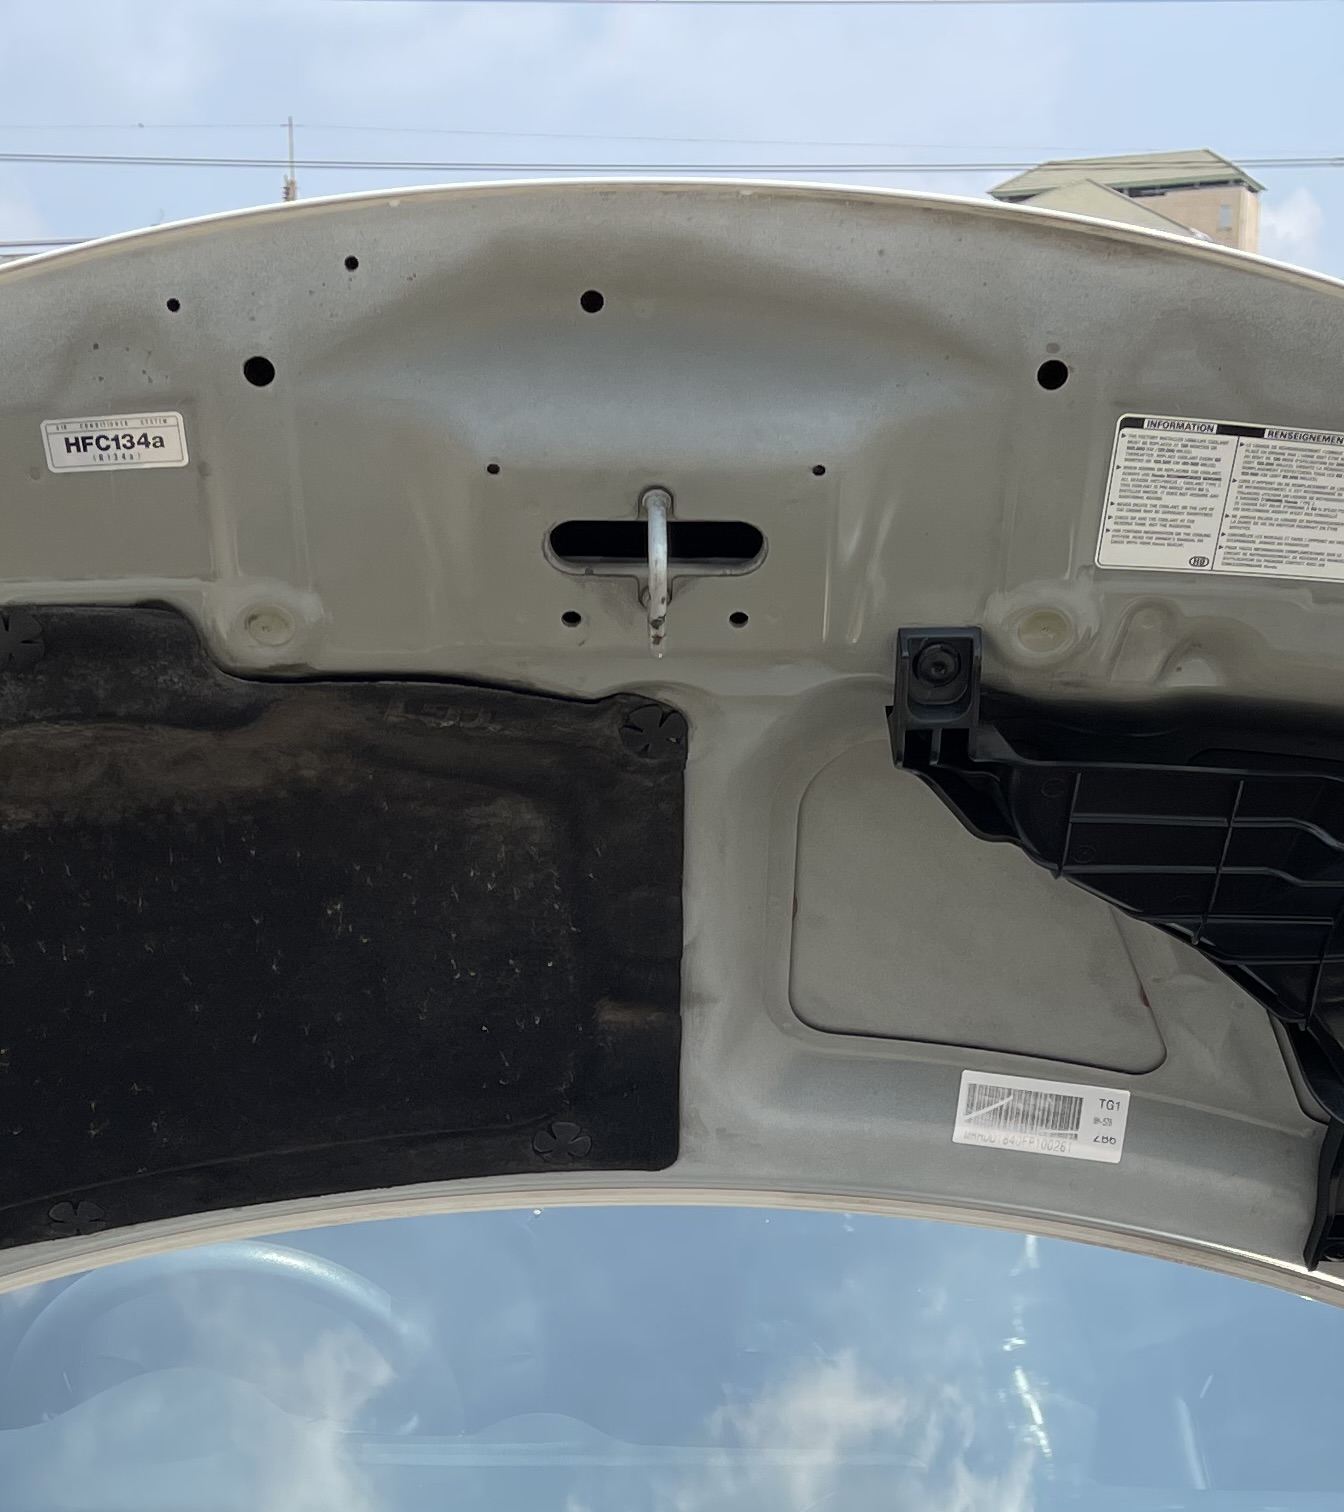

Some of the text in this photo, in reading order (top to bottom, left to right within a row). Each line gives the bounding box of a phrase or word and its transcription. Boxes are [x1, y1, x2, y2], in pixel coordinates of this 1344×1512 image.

[1146, 419, 1215, 433] INFORMATION
[64, 432, 165, 454] HFC134a
[1099, 1098, 1121, 1112] TG1
